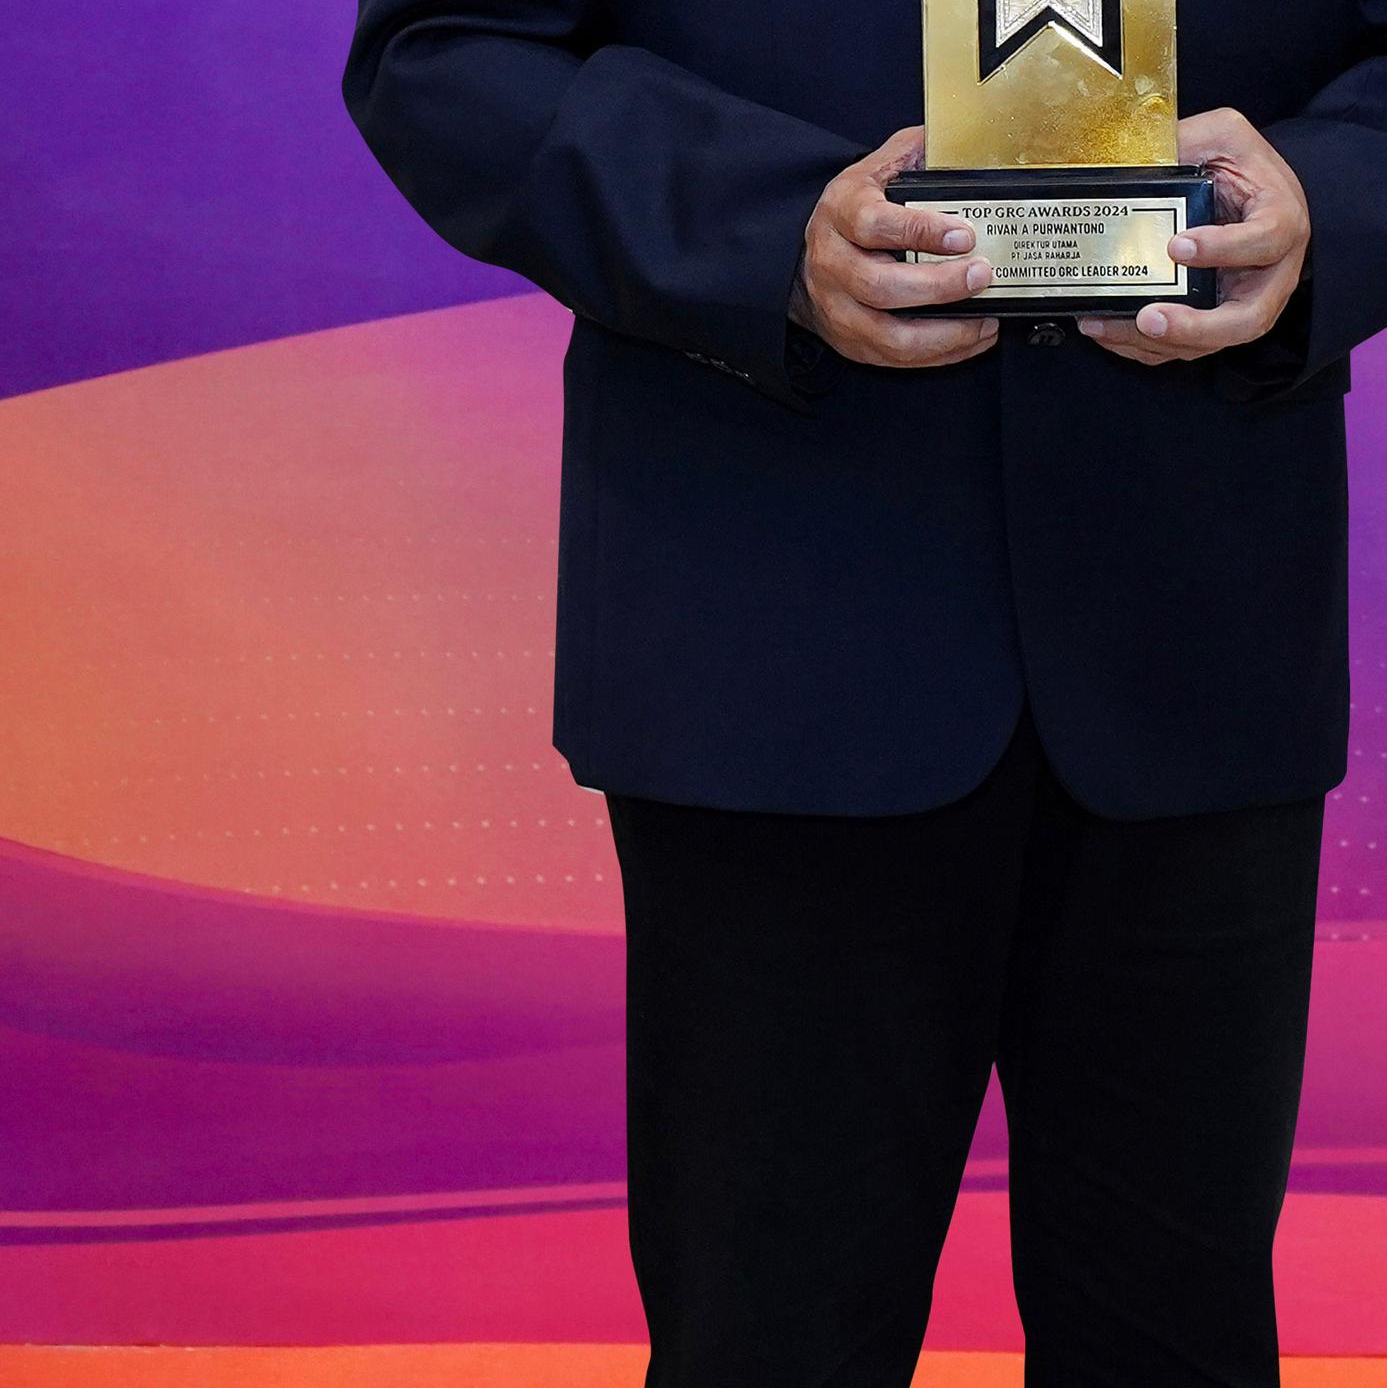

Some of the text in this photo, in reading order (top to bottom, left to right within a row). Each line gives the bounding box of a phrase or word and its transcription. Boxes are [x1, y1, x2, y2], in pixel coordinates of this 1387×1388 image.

[963, 205, 1128, 218] TOP GRC AWARDS 2024
[987, 223, 1104, 235] RIVAN A PURWANTONO
[1014, 240, 1077, 249] DIREKTUR UTAMA
[1012, 251, 1081, 260] PT JASA RAHARJA
[995, 267, 1056, 278] COMMITTED
[1059, 266, 1078, 277] GRC
[1082, 266, 1119, 276] LEADER
[1122, 265, 1148, 276] 2024
